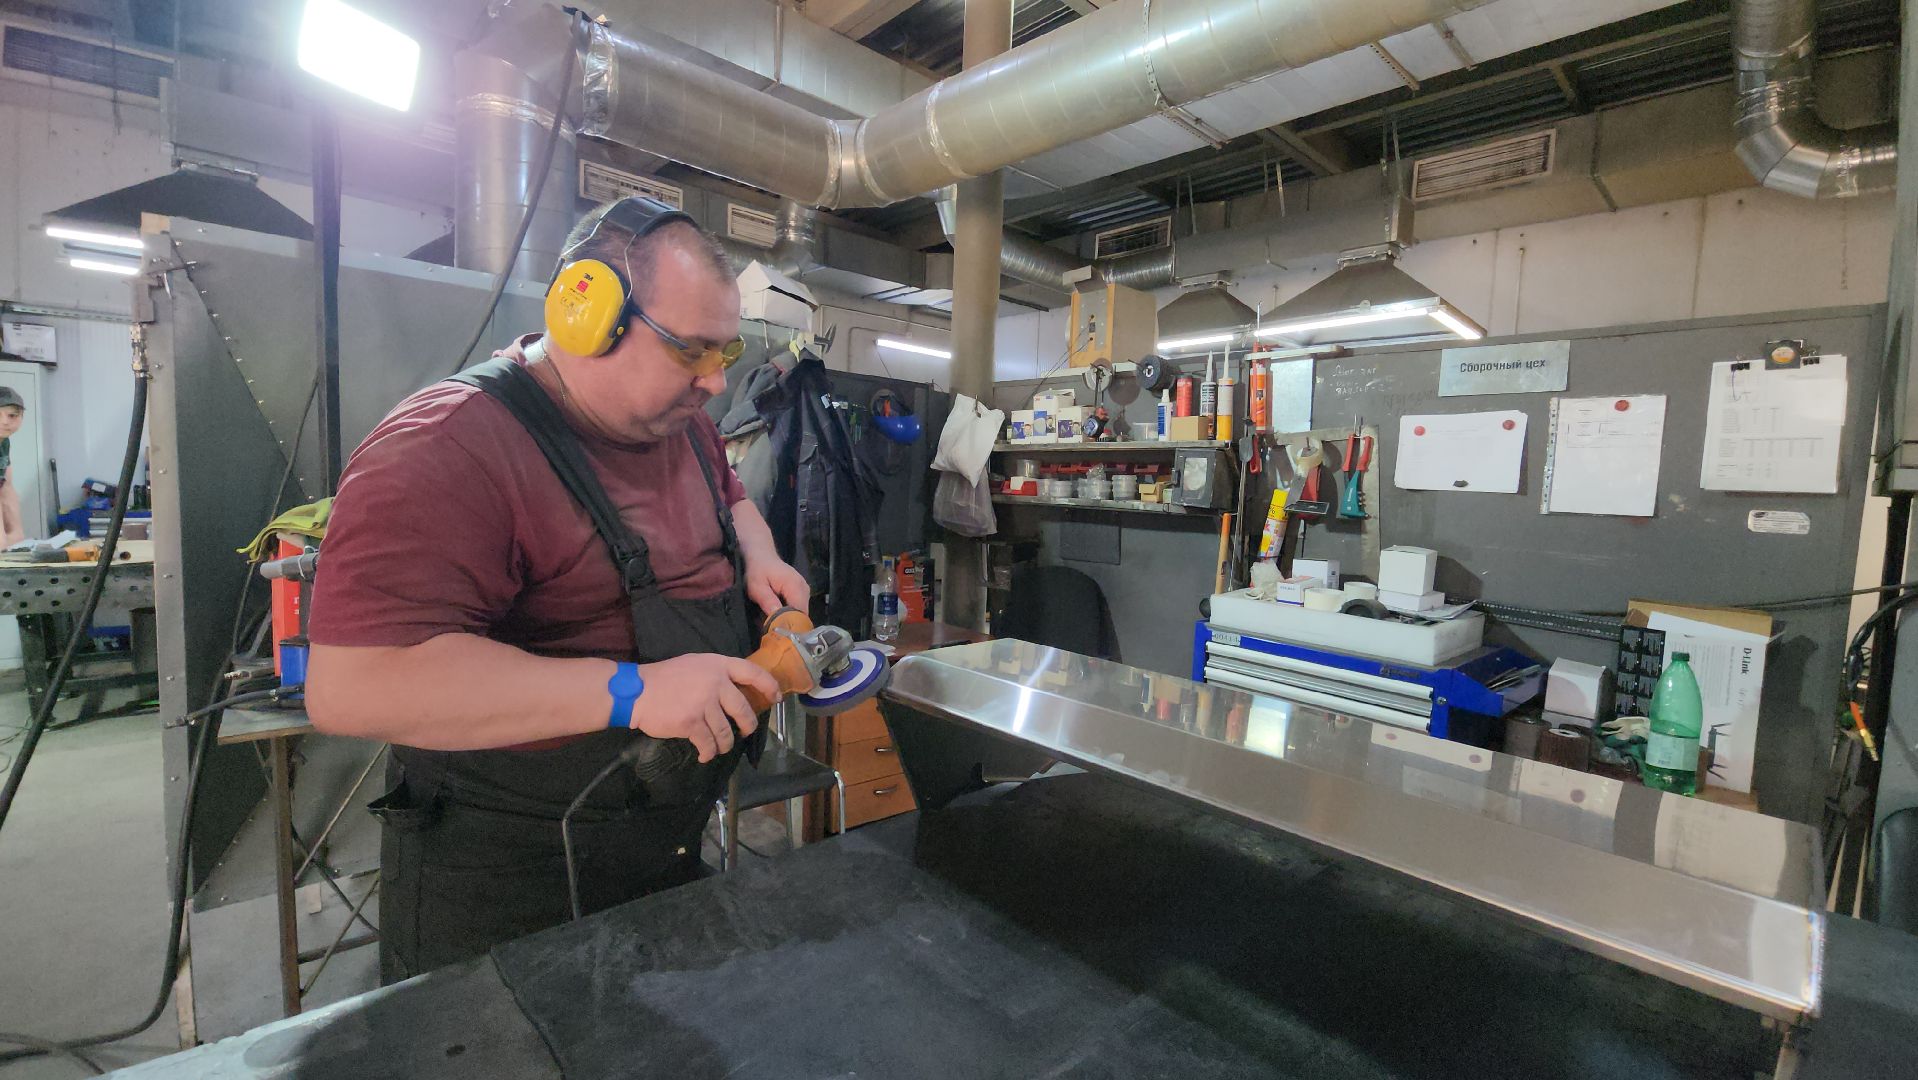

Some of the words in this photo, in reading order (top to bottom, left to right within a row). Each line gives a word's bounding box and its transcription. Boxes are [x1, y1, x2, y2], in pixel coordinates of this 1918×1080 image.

[1460, 360, 1522, 373] Сборочный
[1525, 359, 1546, 370] цех
[1741, 647, 1752, 674] D-Link
